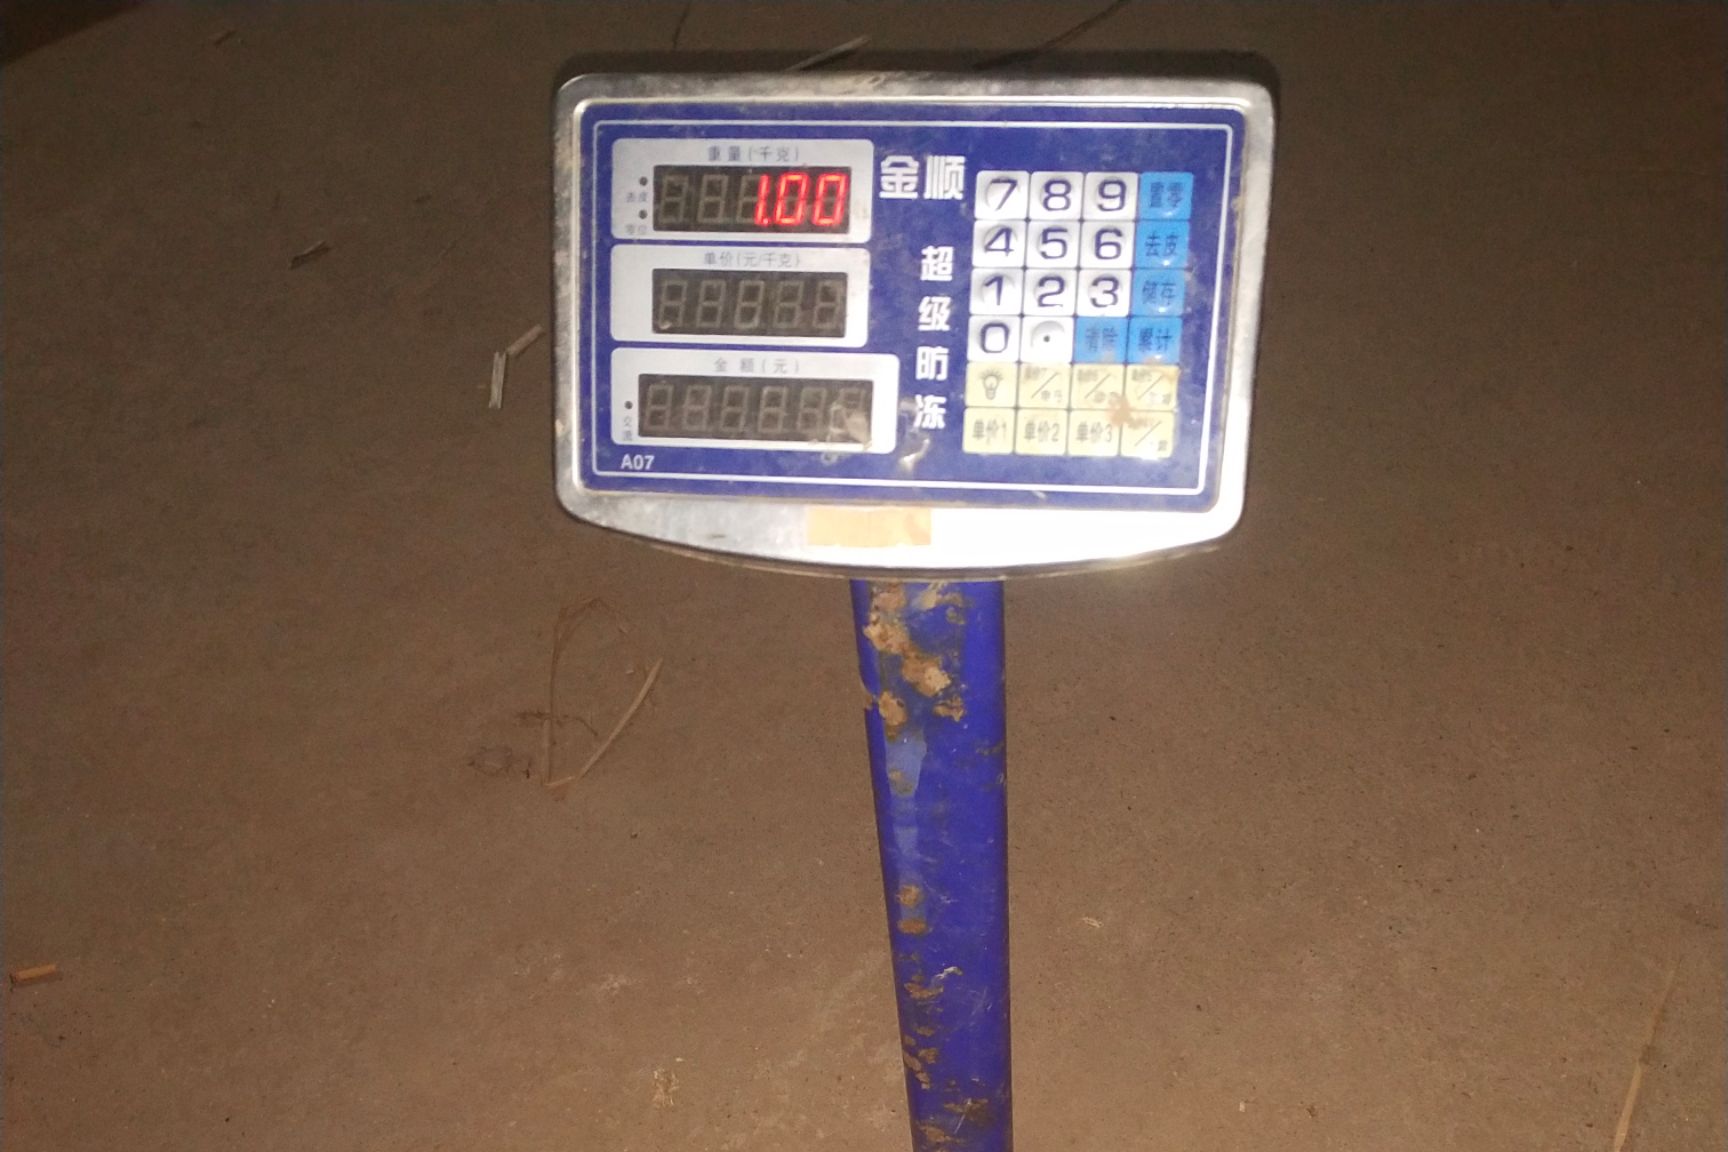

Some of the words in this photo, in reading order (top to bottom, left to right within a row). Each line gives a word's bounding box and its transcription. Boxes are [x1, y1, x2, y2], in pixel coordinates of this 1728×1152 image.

[879, 155, 966, 200] 金顺
[754, 171, 849, 227] 1.00
[988, 178, 1018, 212] 7
[1042, 178, 1072, 212] 8
[1097, 178, 1127, 212] 9
[983, 226, 1015, 257] 4
[1039, 226, 1068, 260] 5
[1094, 227, 1123, 260] 6
[1144, 232, 1179, 257] 去皮
[982, 275, 1004, 306] 1
[1037, 275, 1066, 308] 2
[1090, 275, 1120, 308] 3
[913, 245, 954, 429] 超级防冻
[980, 321, 1010, 354] 0
[1138, 327, 1173, 352] 累计
[621, 454, 655, 470] A07
